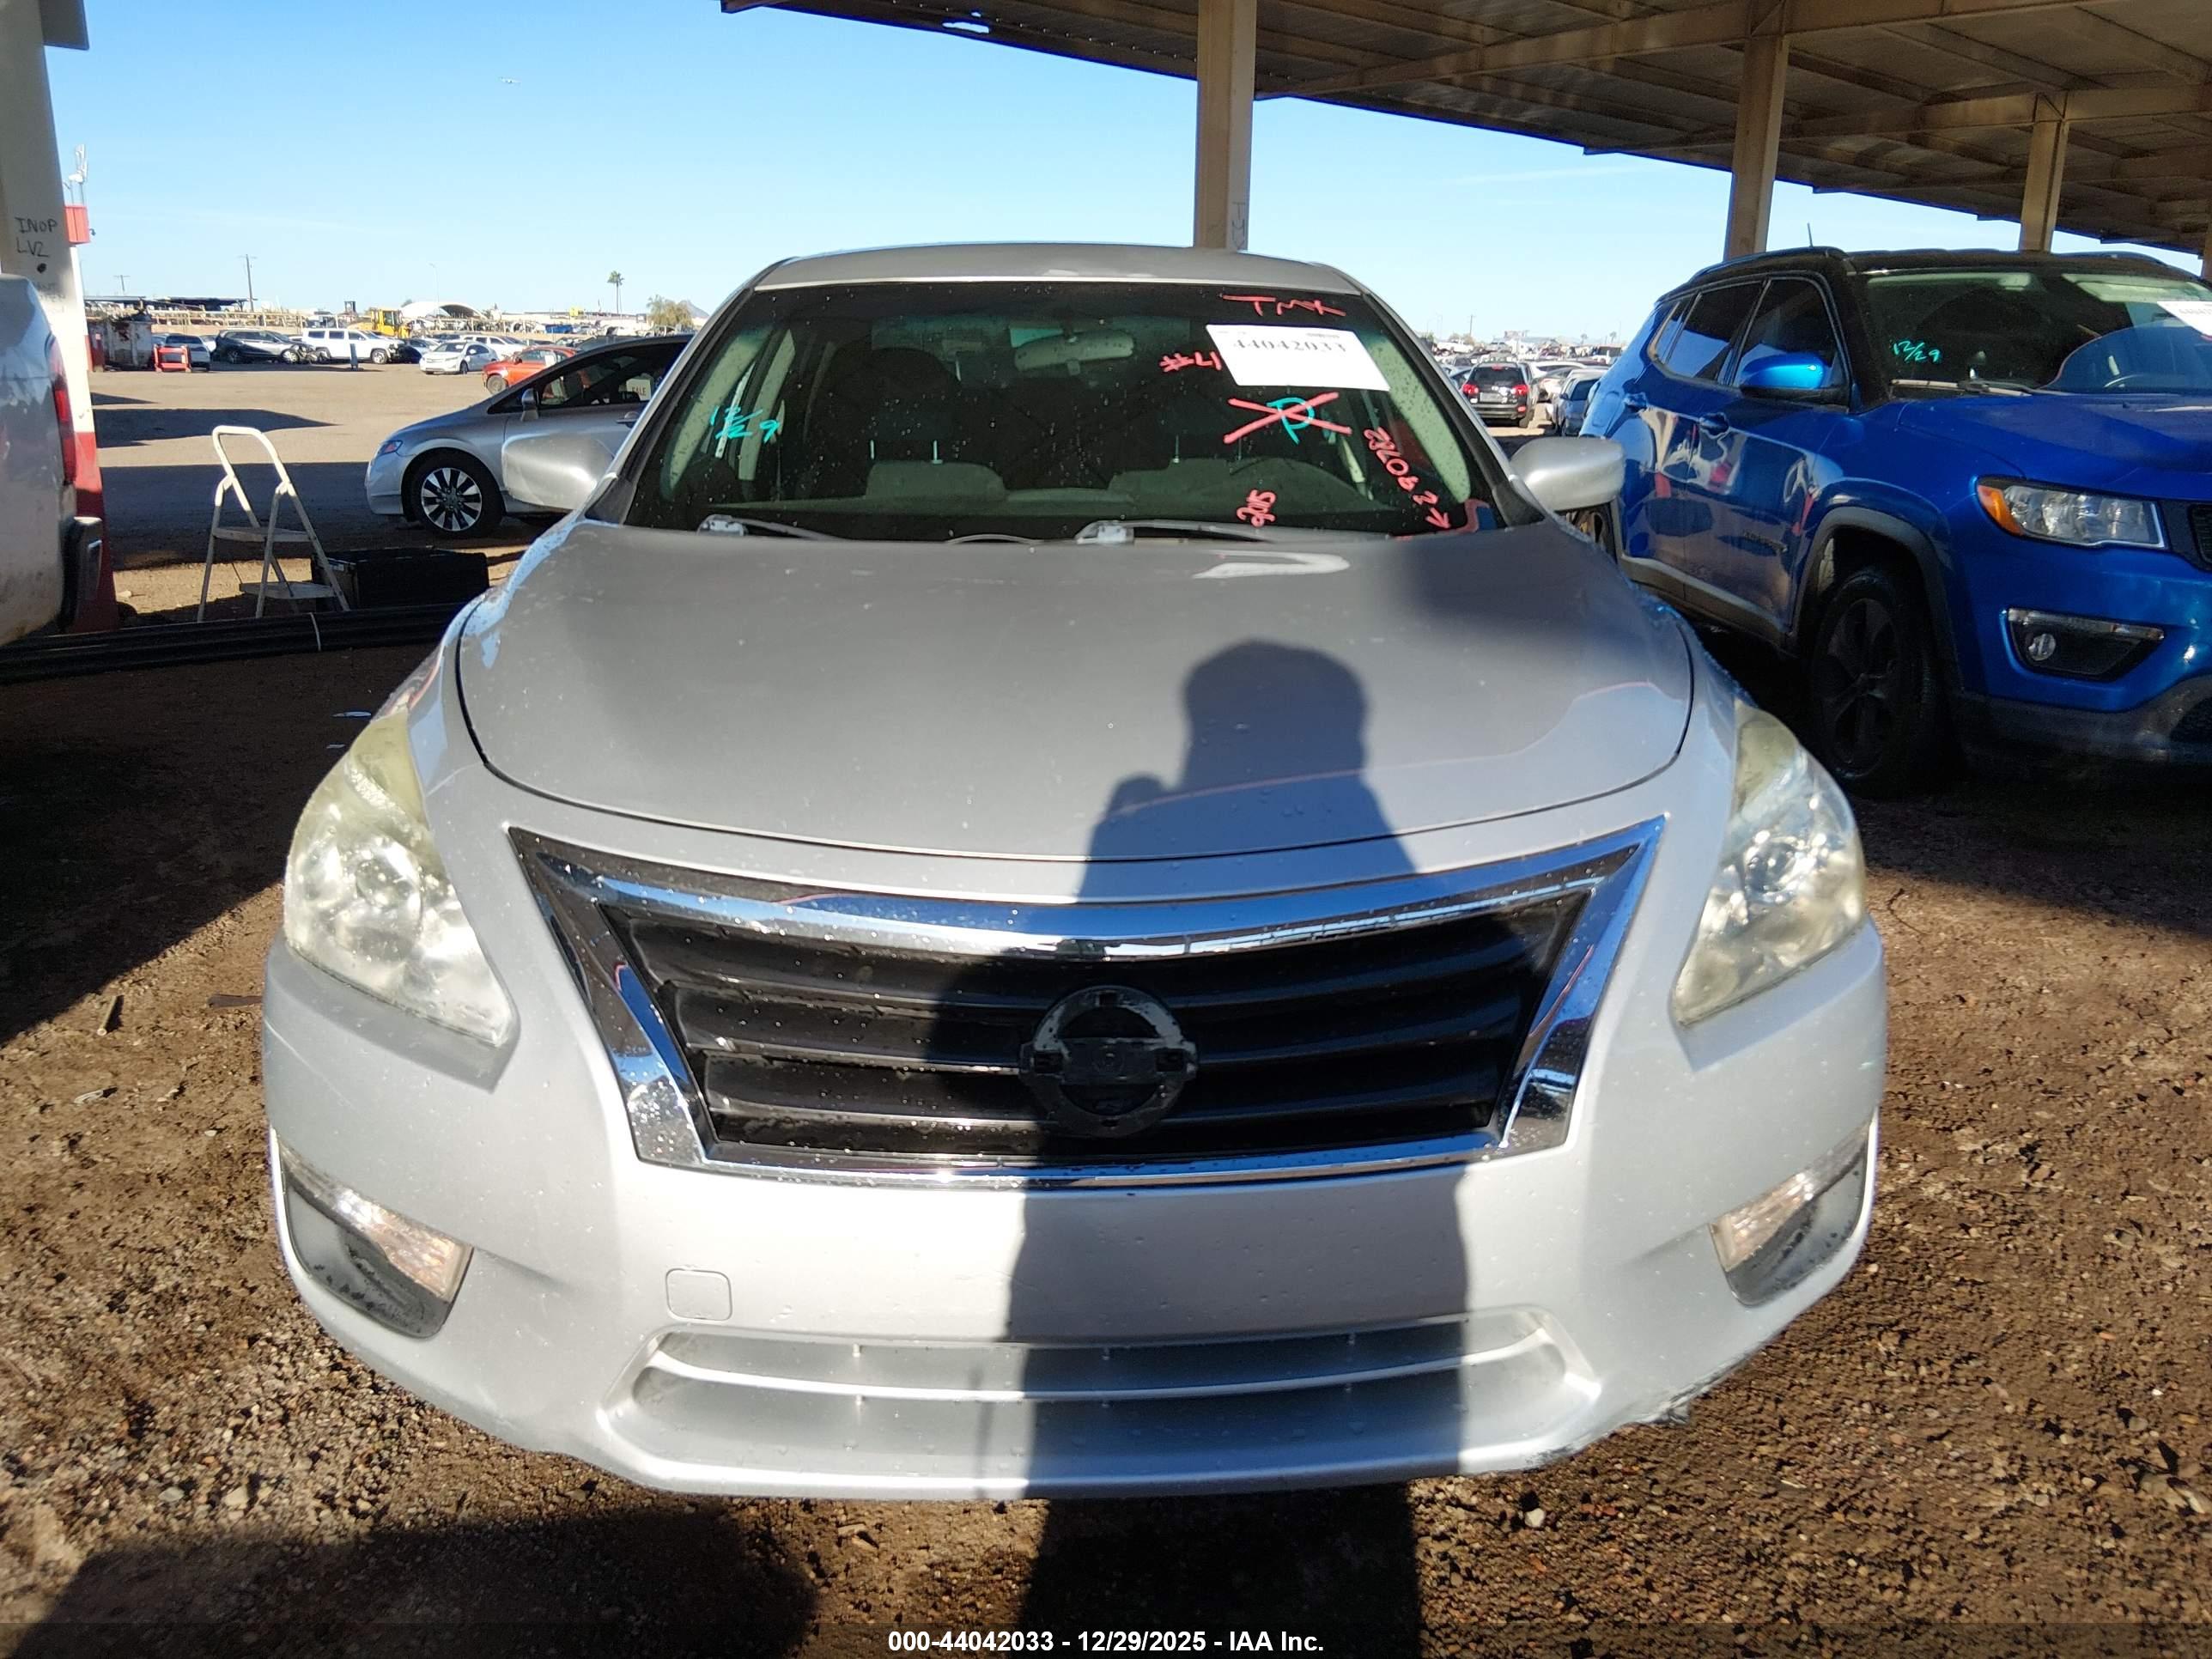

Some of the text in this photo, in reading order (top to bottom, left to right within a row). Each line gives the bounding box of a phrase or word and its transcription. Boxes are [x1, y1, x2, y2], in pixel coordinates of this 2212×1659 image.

[15, 216, 58, 234] INOP
[1158, 351, 1223, 373] #4
[1892, 341, 1942, 363] 12/29
